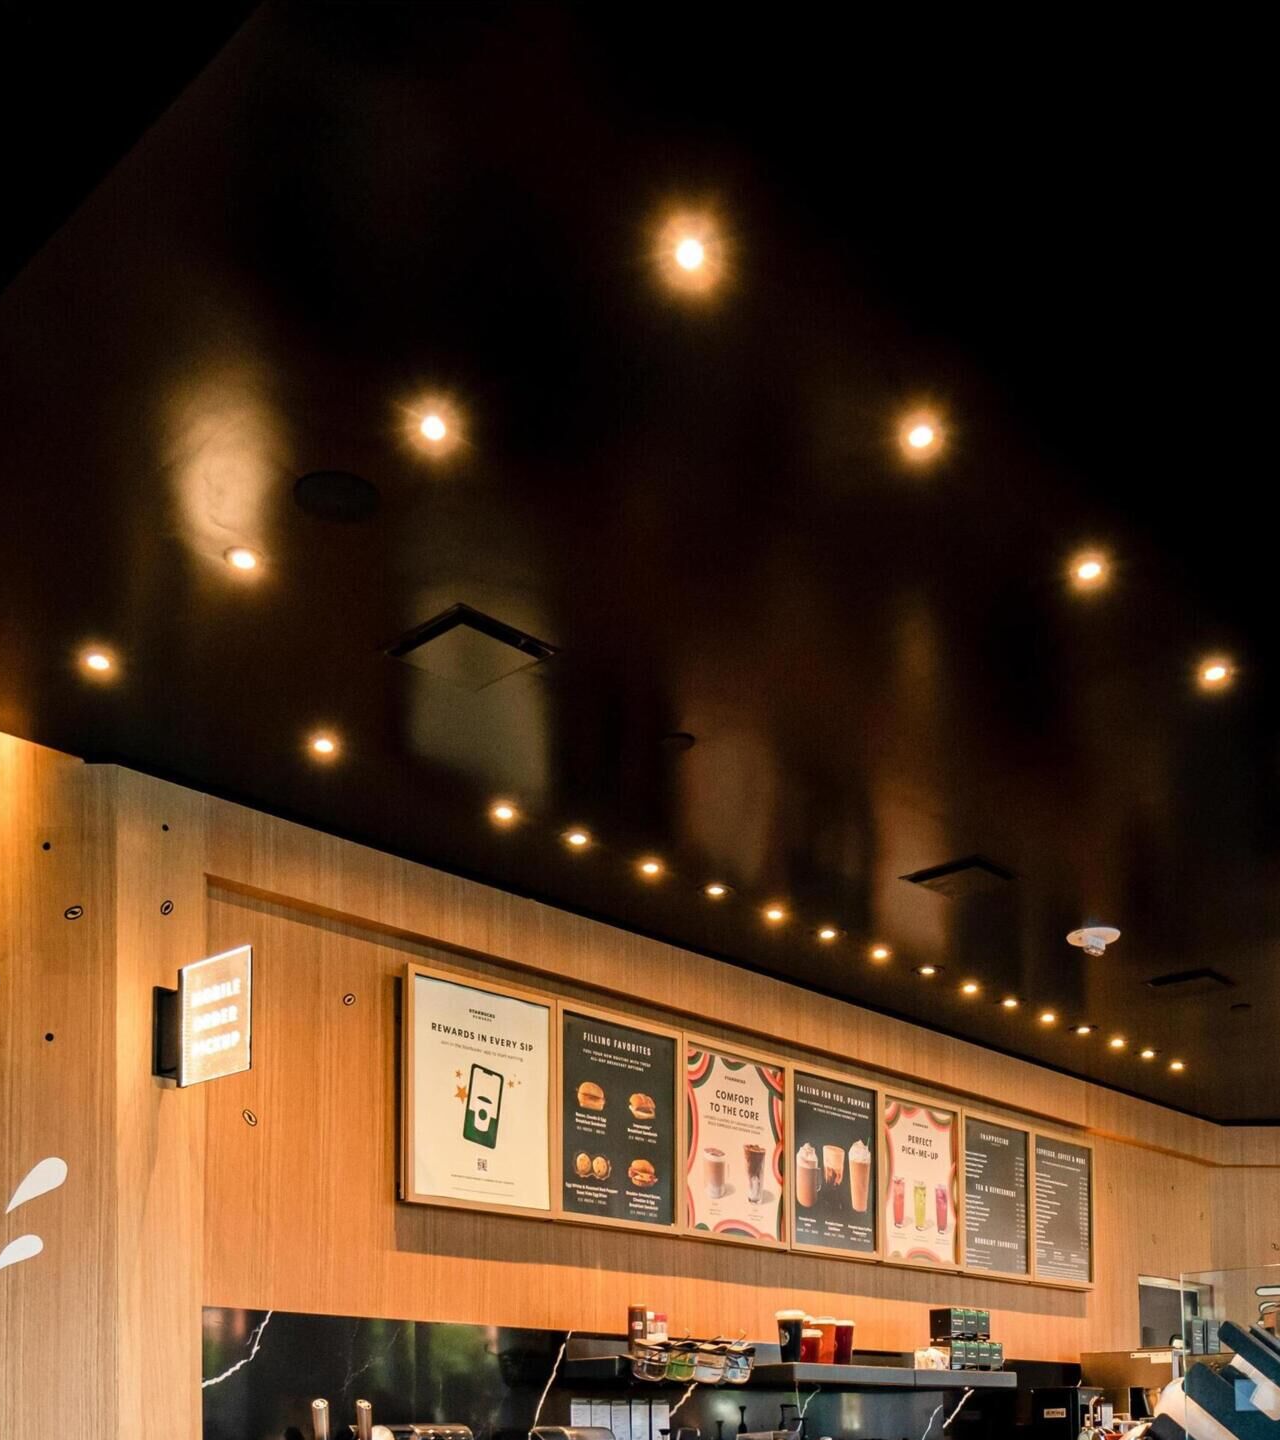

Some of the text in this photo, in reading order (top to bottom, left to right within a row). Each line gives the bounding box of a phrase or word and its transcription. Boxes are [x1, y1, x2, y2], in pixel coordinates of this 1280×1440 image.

[191, 977, 240, 1008] MOBILE
[192, 1005, 238, 1032] ORDER
[192, 1031, 240, 1057] PICKUP
[431, 1022, 534, 1053] REWARDS IN EVERY SIP
[583, 1032, 651, 1056] FILLING FAVORITES
[715, 1089, 754, 1106] COMFORT
[797, 1083, 819, 1097] FALLING
[821, 1090, 831, 1100] FOR
[847, 1097, 870, 1110] PUMPKIN
[710, 1102, 759, 1121] TO THE CORE
[902, 1145, 938, 1160] PICK-ME-UP
[908, 1134, 932, 1148] PERFECT
[1071, 1155, 1075, 1163] &
